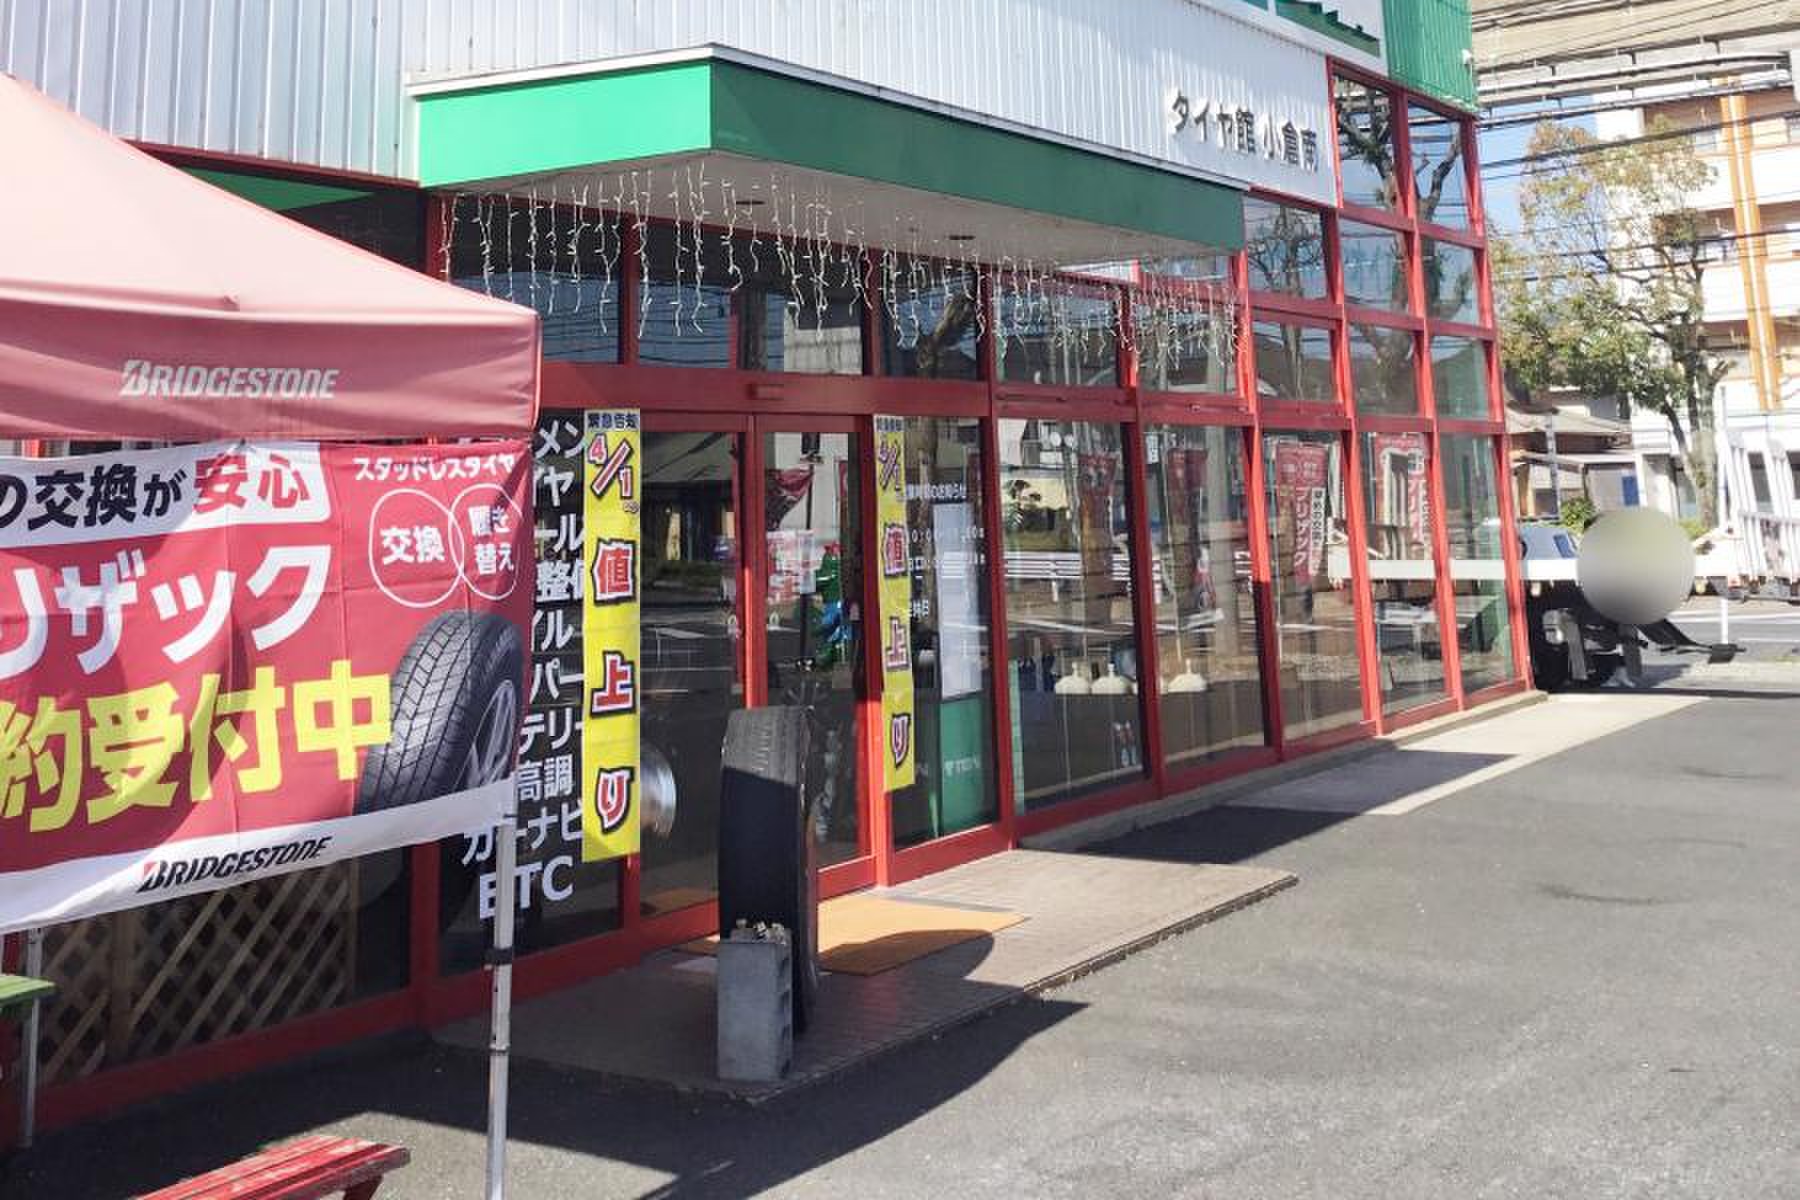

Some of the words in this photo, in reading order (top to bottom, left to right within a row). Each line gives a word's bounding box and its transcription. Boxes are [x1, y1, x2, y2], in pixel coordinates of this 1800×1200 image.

[1172, 90, 1256, 154] タイヤ館
[118, 359, 340, 400] BRIDGESTONE
[353, 453, 516, 482] スタッドレスタイヤ
[379, 524, 446, 566] 交換
[474, 542, 515, 576] 替え
[0, 660, 392, 832] 約受付中
[137, 836, 332, 893] BRIDGESTONE
